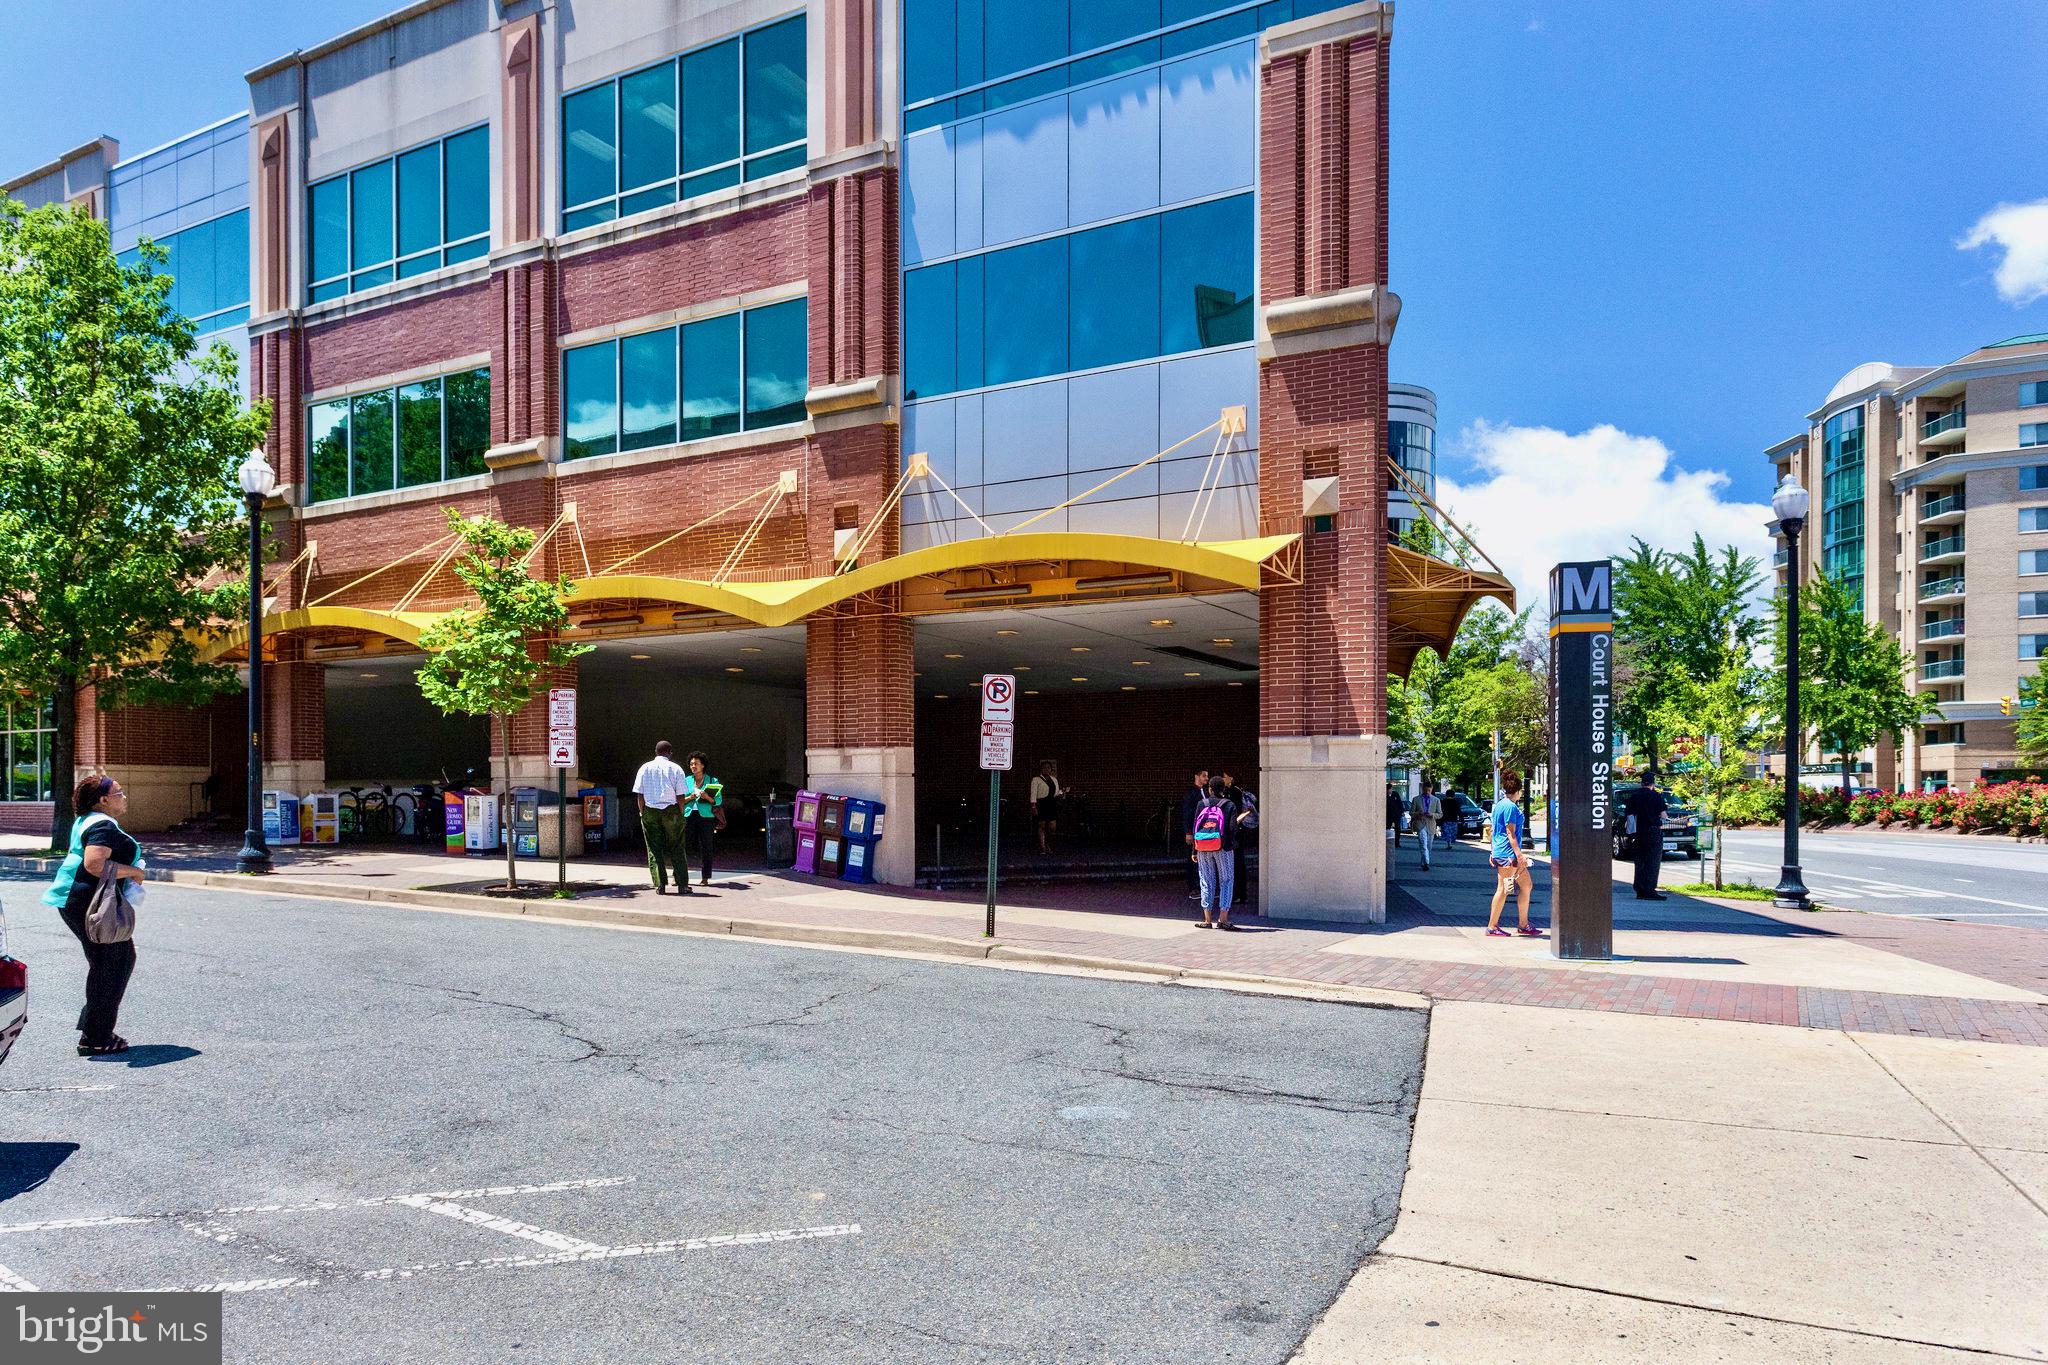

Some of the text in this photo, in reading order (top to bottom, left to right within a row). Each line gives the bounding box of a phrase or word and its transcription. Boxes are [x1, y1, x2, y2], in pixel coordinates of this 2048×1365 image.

[1563, 566, 1609, 611] M
[983, 724, 1012, 734] NO PARKING
[1592, 634, 1609, 830] Court House Station
